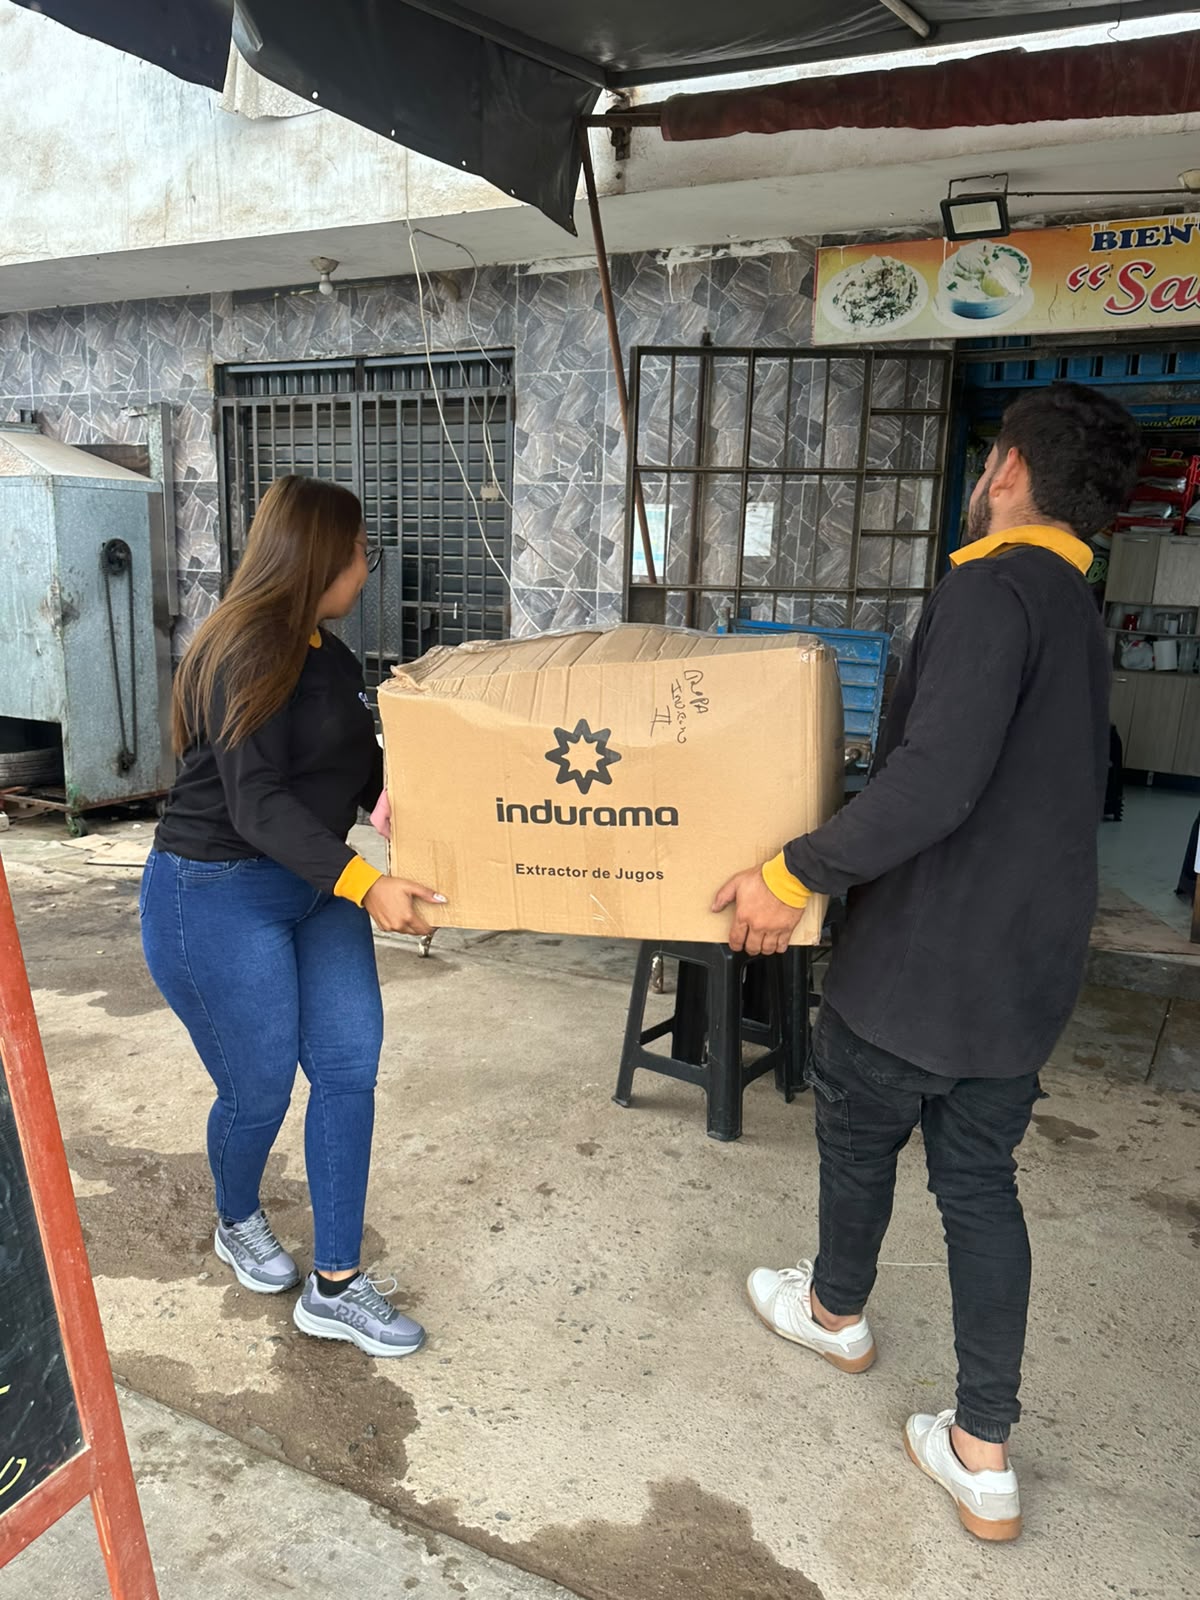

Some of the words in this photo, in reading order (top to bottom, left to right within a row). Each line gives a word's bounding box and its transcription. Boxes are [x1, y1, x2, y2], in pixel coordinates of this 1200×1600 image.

[1090, 223, 1200, 252] BIEN
[1066, 259, 1200, 315] “Sa
[495, 797, 679, 827] indurama
[515, 863, 588, 878] Extractor
[592, 868, 611, 879] de
[615, 868, 665, 883] Jugos
